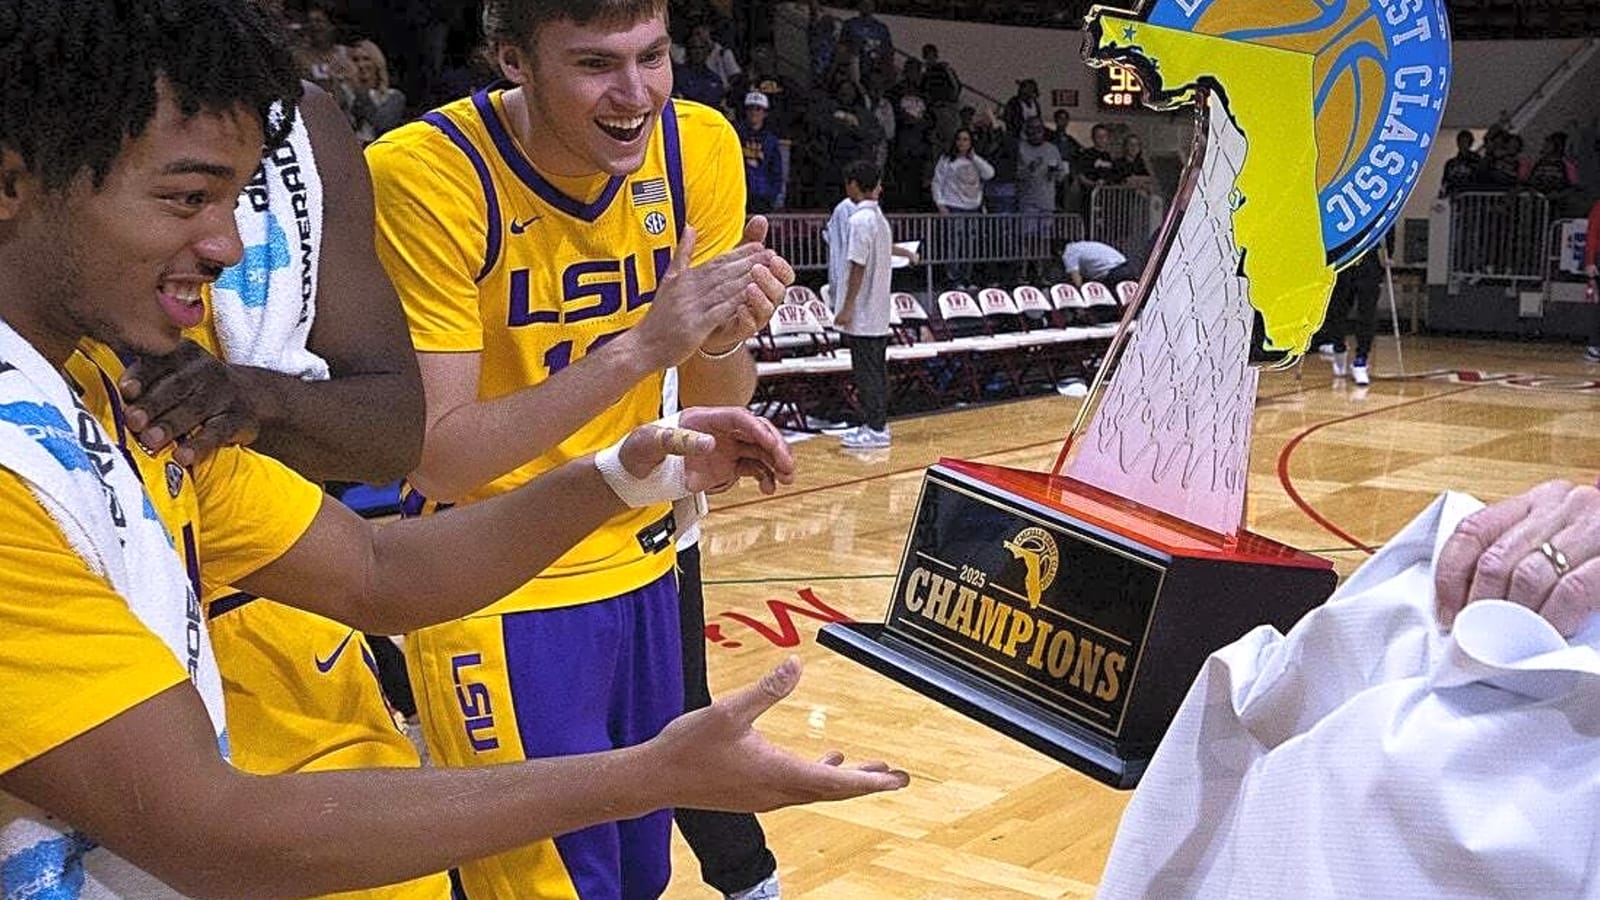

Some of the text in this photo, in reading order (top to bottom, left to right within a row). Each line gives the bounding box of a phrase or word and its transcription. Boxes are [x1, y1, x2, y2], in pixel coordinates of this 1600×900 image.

[1327, 64, 1432, 232] CLASSIC
[507, 246, 671, 327] LSU
[960, 564, 987, 588] 2025
[905, 567, 1127, 701] CHAMPIONS
[452, 653, 500, 752] LSU
